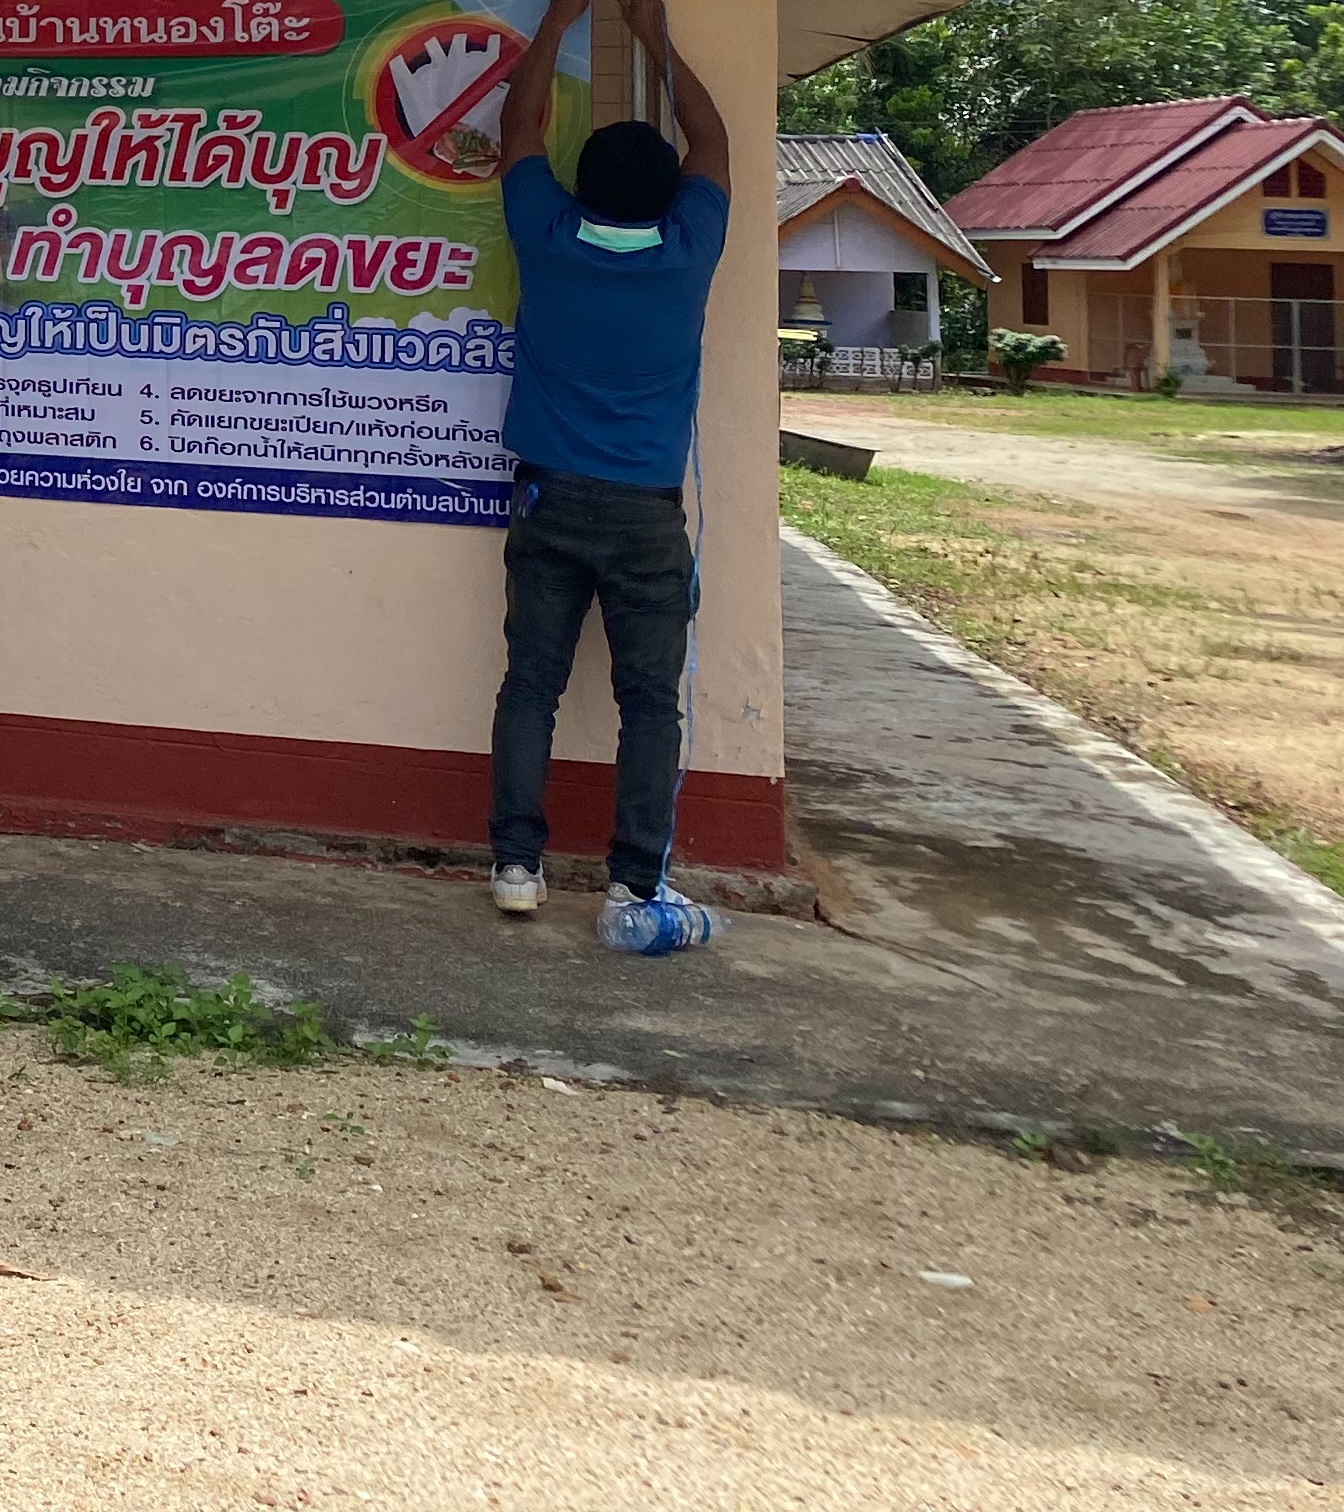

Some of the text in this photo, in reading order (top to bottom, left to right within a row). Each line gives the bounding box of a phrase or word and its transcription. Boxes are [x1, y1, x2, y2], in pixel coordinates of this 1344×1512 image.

[8, 206, 477, 309] ทำบุญลดขยะ
[138, 383, 450, 414] 4. ลดขยะจากการใช้พวงหรีด
[138, 408, 502, 445] 5. คัดแยกขยะเปียก/แห้งก่อนทิ้งล
[138, 435, 522, 472] 6. ปิดก๊อกน้ำให้สนิททุกครั้งหลังเลิก
[150, 476, 189, 497] จาก
[196, 478, 511, 517] องค์การบริหารส่วนตำบลบ้านน
